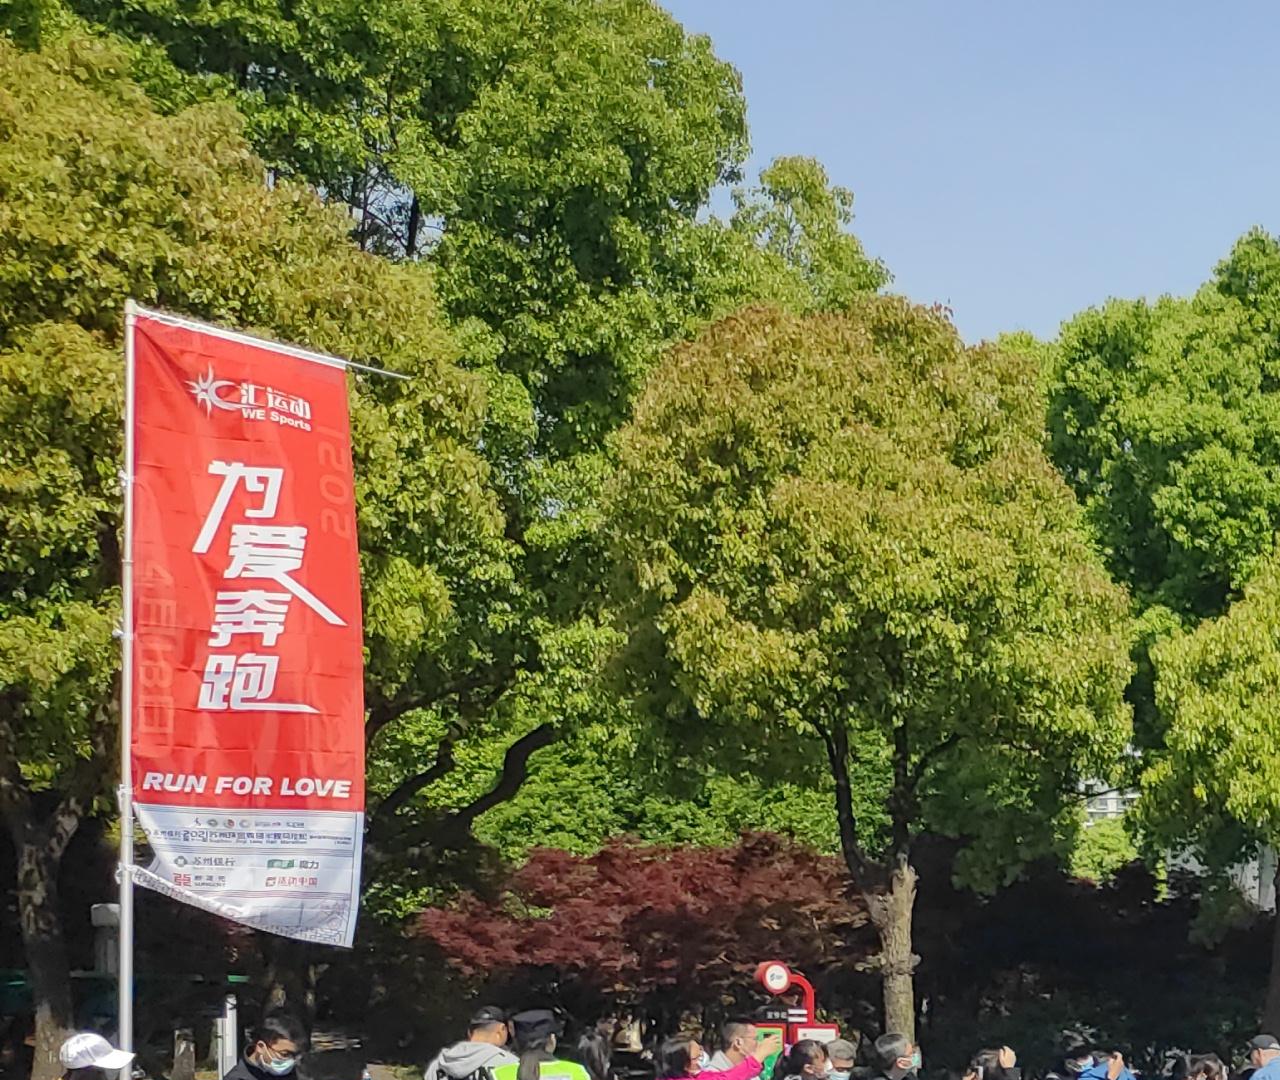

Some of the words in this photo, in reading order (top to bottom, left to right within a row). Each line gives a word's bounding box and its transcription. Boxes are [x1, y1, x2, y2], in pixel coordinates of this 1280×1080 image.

[242, 408, 266, 420] WE
[270, 411, 312, 432] Sports
[193, 460, 348, 716] 为爱奔跑
[142, 772, 208, 793] RUN
[215, 774, 271, 796] FOR
[279, 776, 352, 798] LOVE
